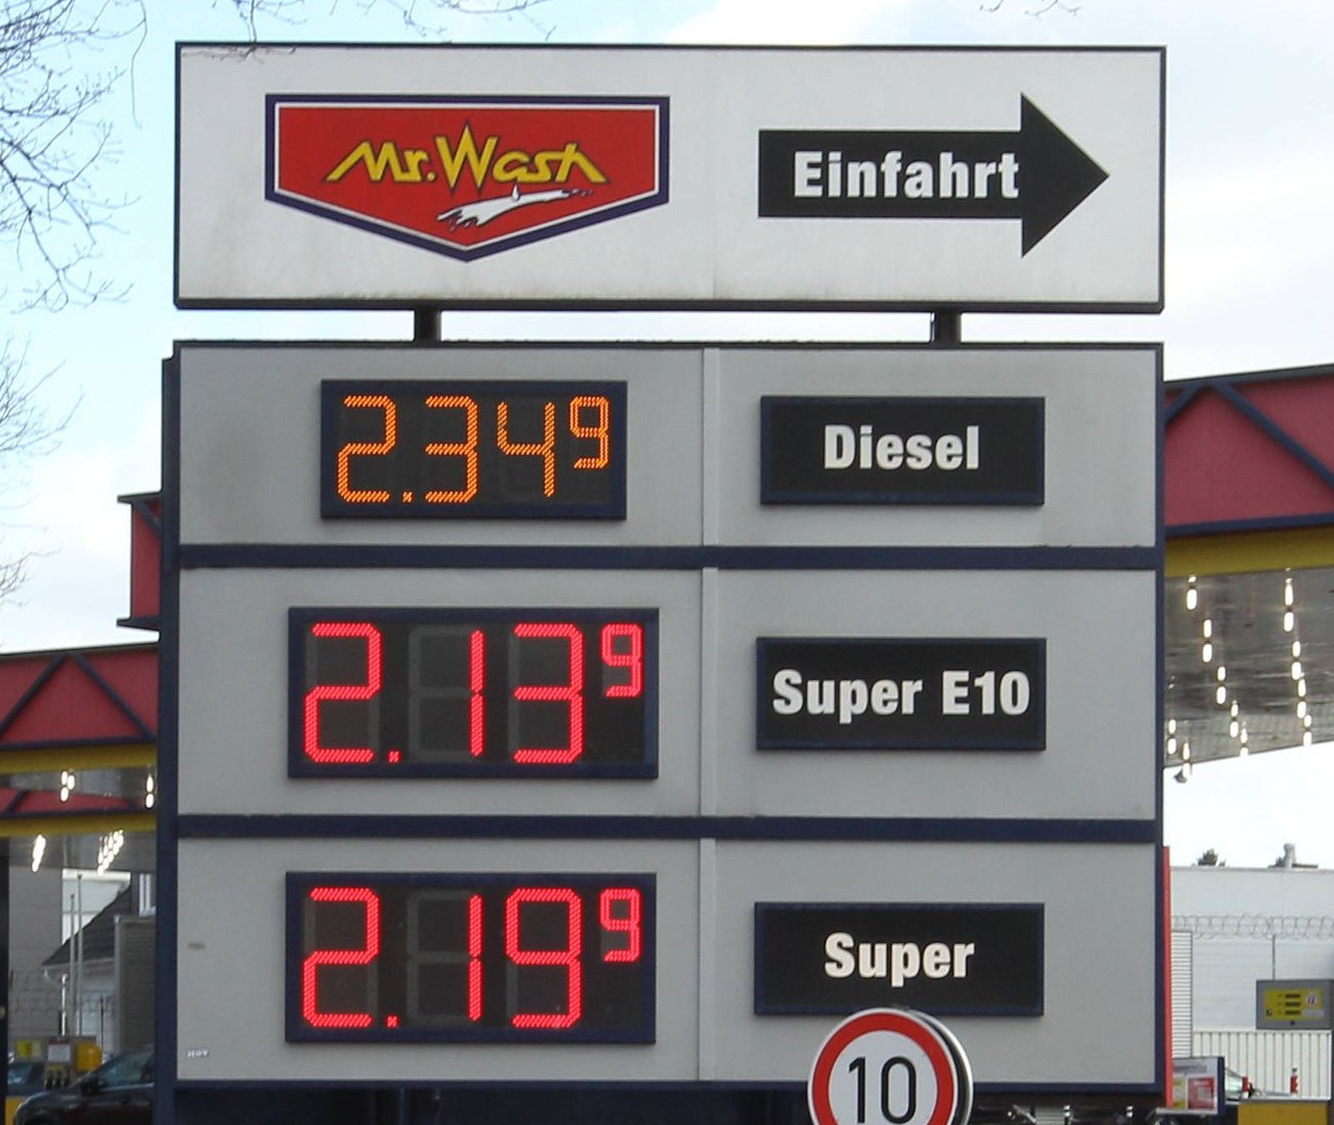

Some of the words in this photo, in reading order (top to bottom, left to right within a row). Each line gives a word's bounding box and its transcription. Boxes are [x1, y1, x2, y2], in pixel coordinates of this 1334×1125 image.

[794, 150, 1020, 198] Einfahrt
[824, 425, 979, 470] Diesel
[773, 669, 923, 724] Super
[942, 670, 1030, 715] E10
[824, 932, 975, 987] Super
[848, 1056, 917, 1125] 10
